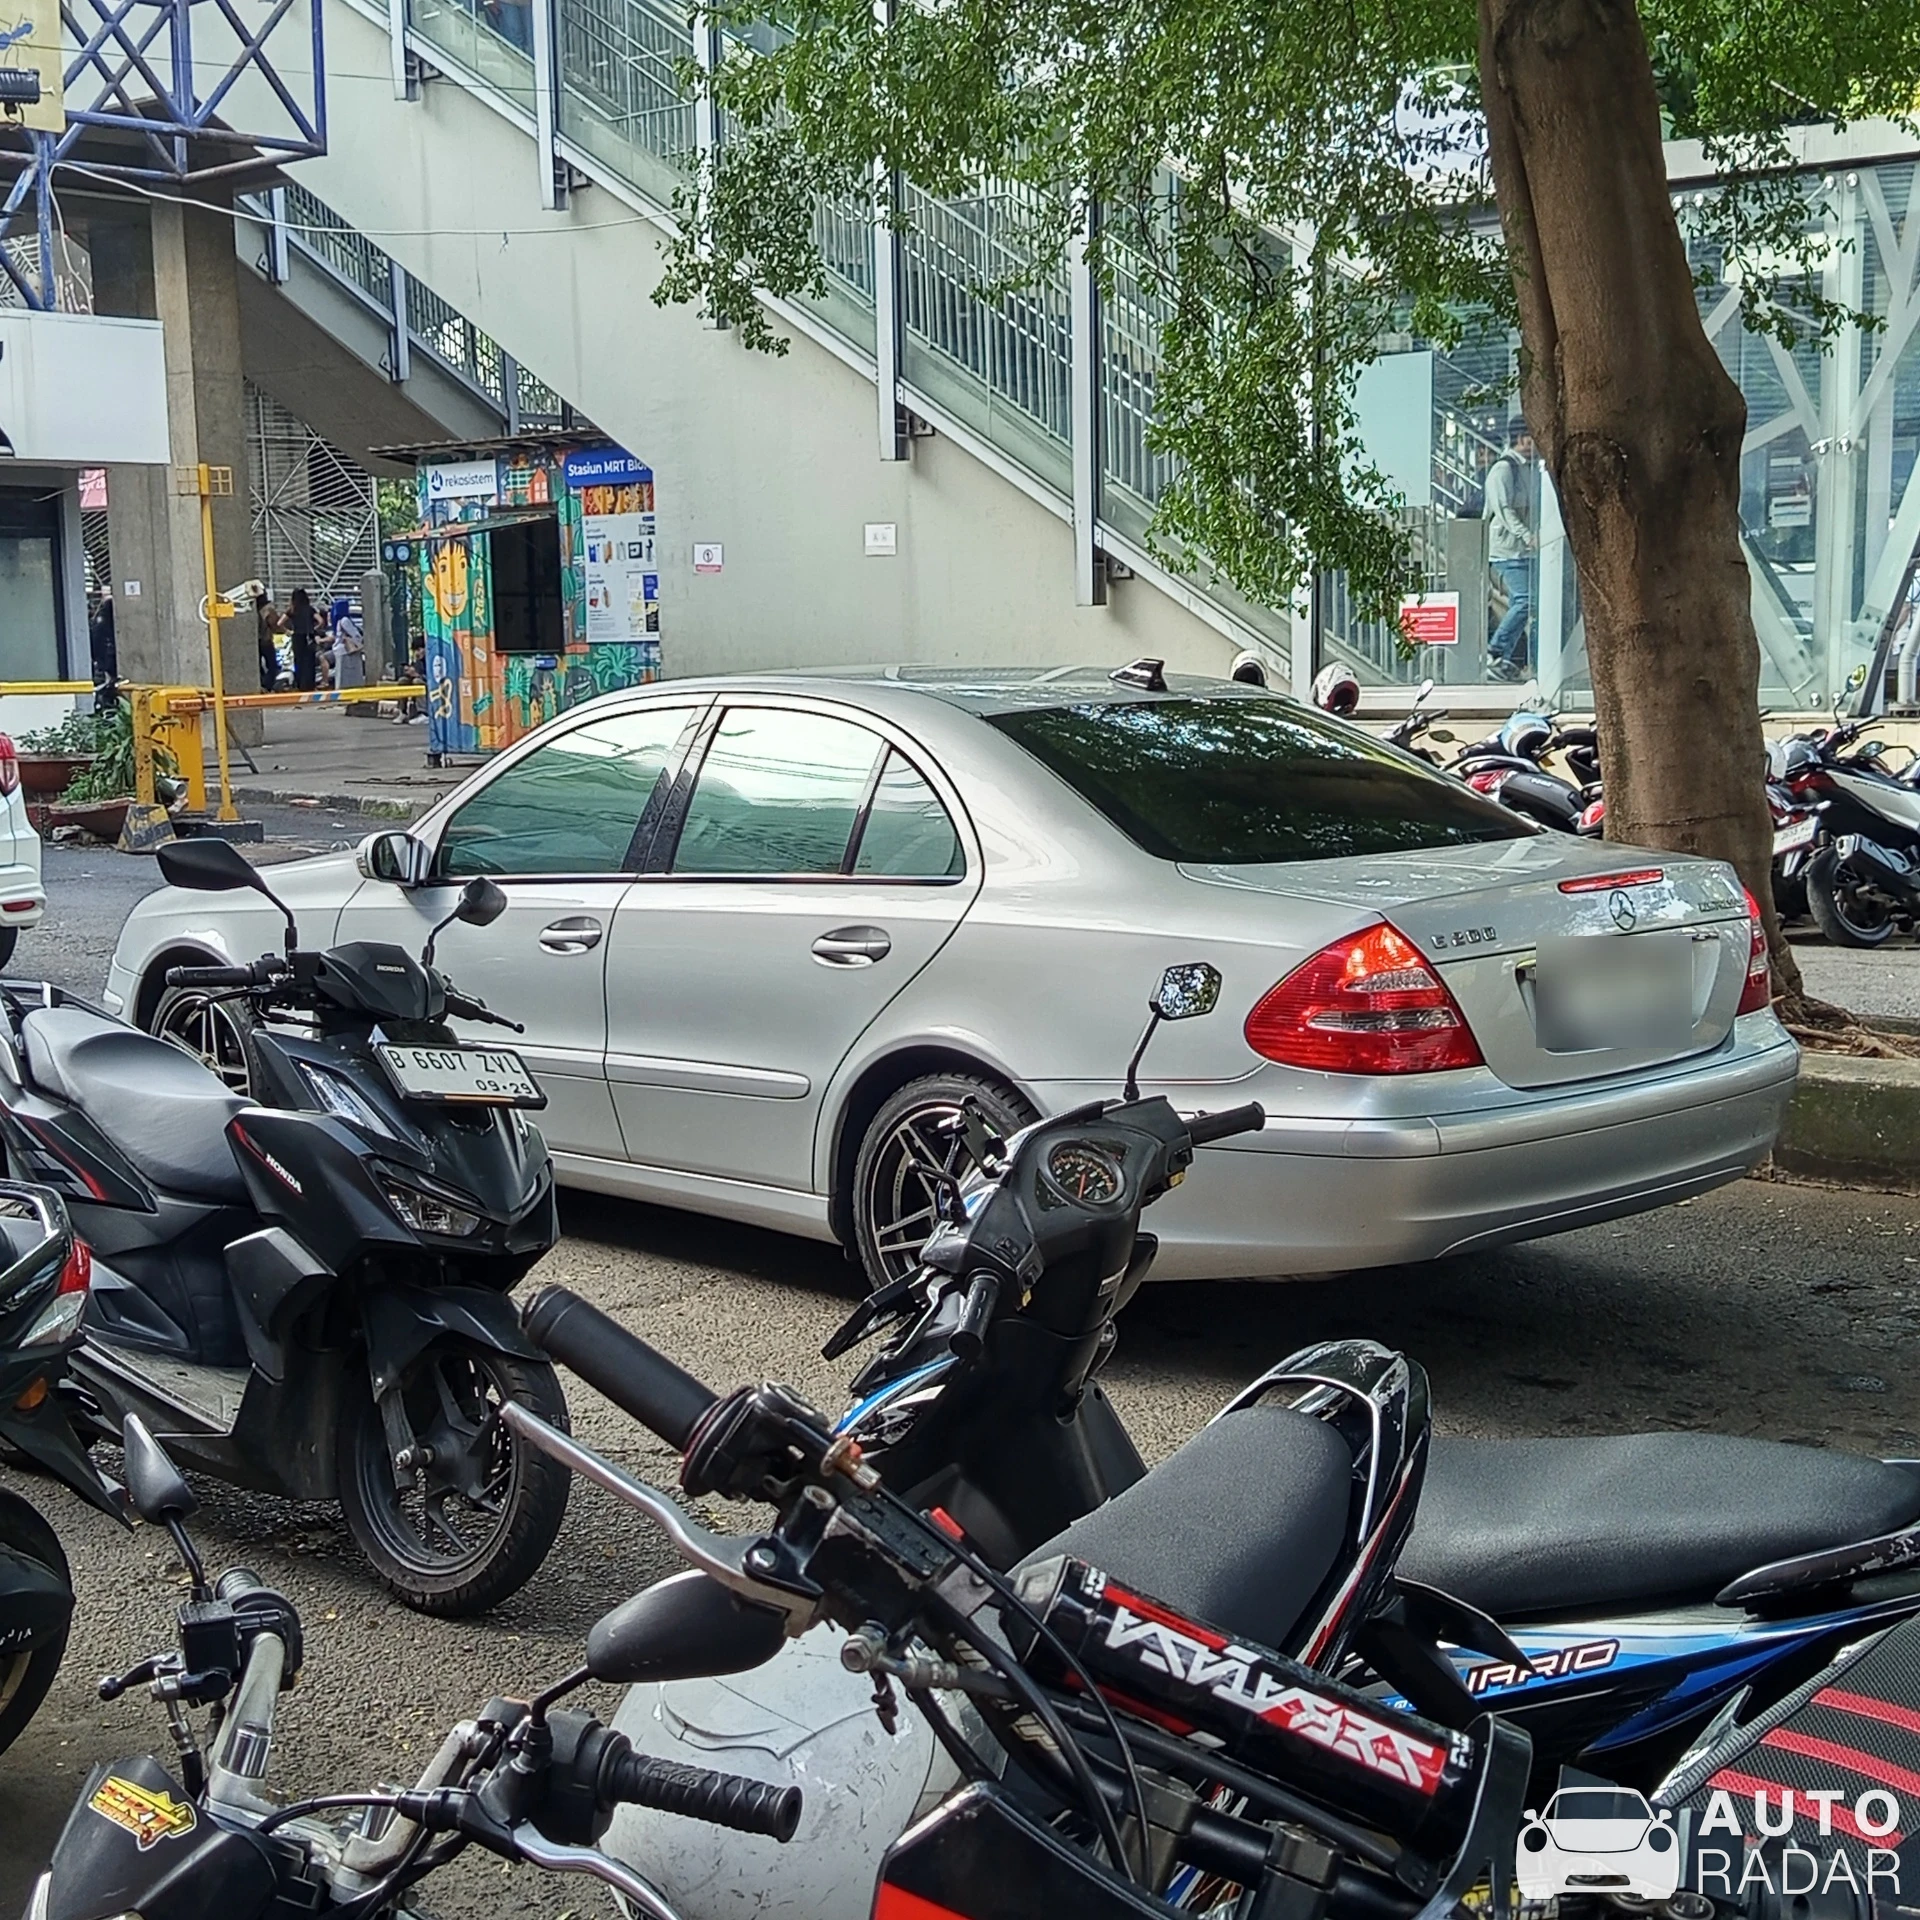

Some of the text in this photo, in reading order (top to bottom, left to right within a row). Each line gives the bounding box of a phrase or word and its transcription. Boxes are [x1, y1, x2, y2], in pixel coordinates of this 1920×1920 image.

[568, 459, 647, 477] Stasiun MRT Blo
[445, 473, 493, 487] rekosistem
[1431, 927, 1497, 949] E 200
[376, 964, 406, 973] HONDA
[387, 1050, 521, 1074] B 6607 ZYL
[266, 1153, 302, 1193] HONDA
